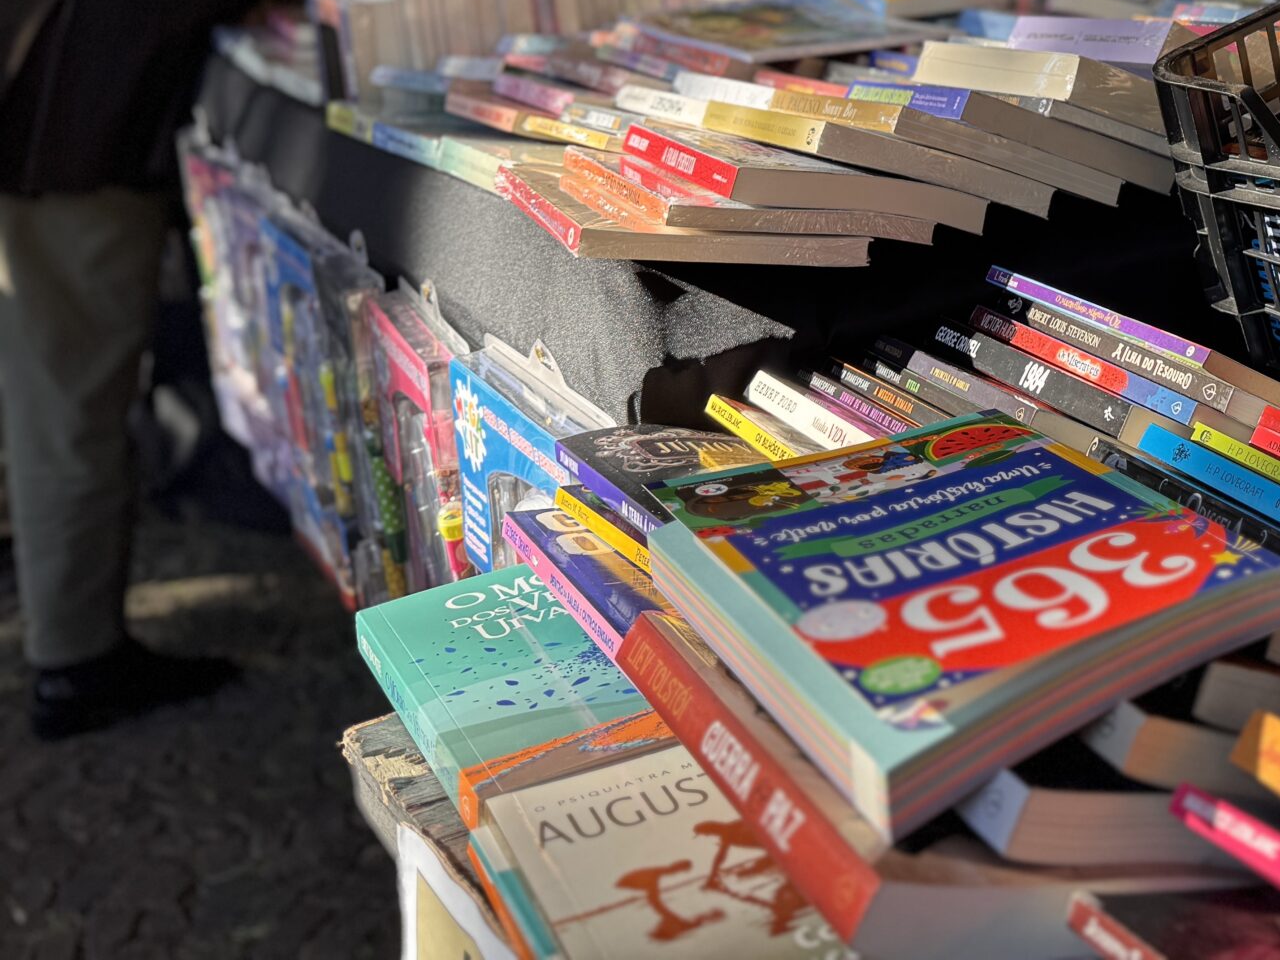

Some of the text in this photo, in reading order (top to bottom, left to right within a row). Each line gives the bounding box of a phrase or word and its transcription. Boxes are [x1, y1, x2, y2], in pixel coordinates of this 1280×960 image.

[980, 313, 1002, 332] VICTOR
[1000, 321, 1018, 341] HUGO
[1109, 313, 1121, 328] Oz
[935, 326, 1050, 394] GEORGE 1984
[1029, 308, 1193, 390] ROBERT LOUIS STEVENSON A ILHA DO TESOURO
[754, 381, 848, 447] HENRY FORD Minha VIDA
[762, 435, 780, 457] BILHÕES
[983, 462, 1040, 484] Uma
[1220, 469, 1264, 499] LOVECRAFT
[858, 495, 1006, 550] narradas
[635, 548, 651, 570] PETER
[804, 489, 1116, 597] HISTÓRIAS
[444, 592, 485, 612] O
[901, 530, 1197, 659] 365
[449, 604, 511, 630] DOS
[472, 605, 570, 642] UIVA
[557, 770, 673, 806] PSIQUIATRA
[699, 719, 806, 854] GUERRA PAZ
[537, 774, 717, 849] AUGUS
